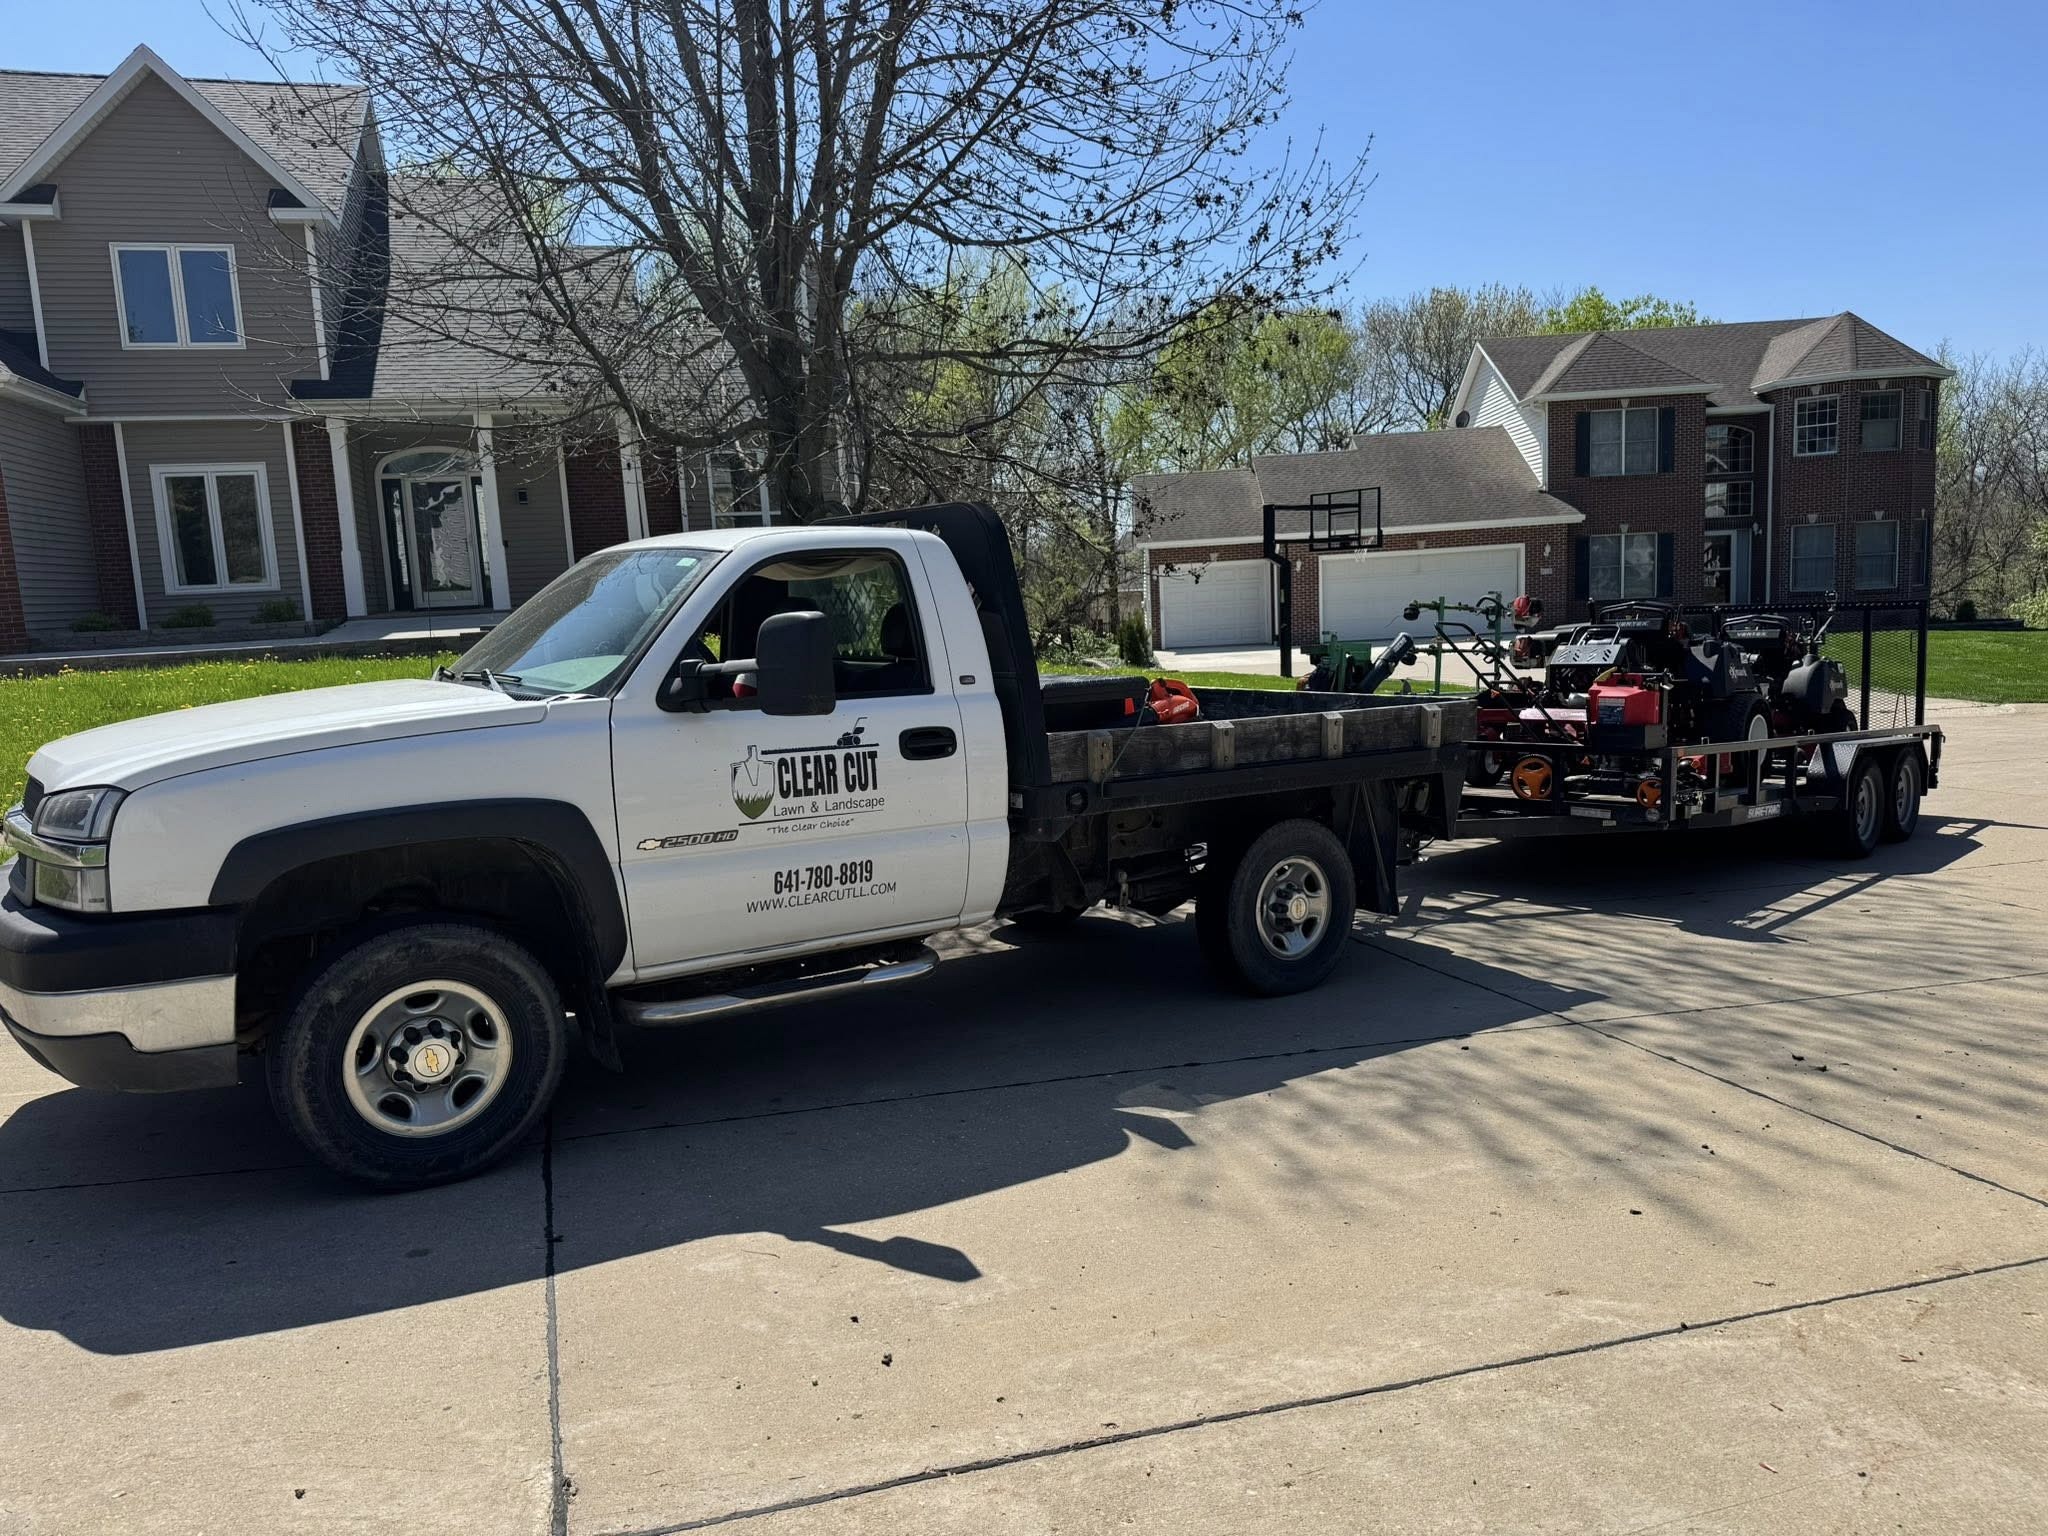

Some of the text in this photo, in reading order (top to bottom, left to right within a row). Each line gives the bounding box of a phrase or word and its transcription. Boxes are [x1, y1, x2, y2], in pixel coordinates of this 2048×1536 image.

[777, 751, 878, 799] CLEAR CUT
[773, 797, 885, 817] Lawn & Landscape
[791, 822, 817, 832] Clear
[774, 859, 873, 895] 641-780-8819
[746, 881, 897, 913] WWW.CLEARCUTLL.COM
